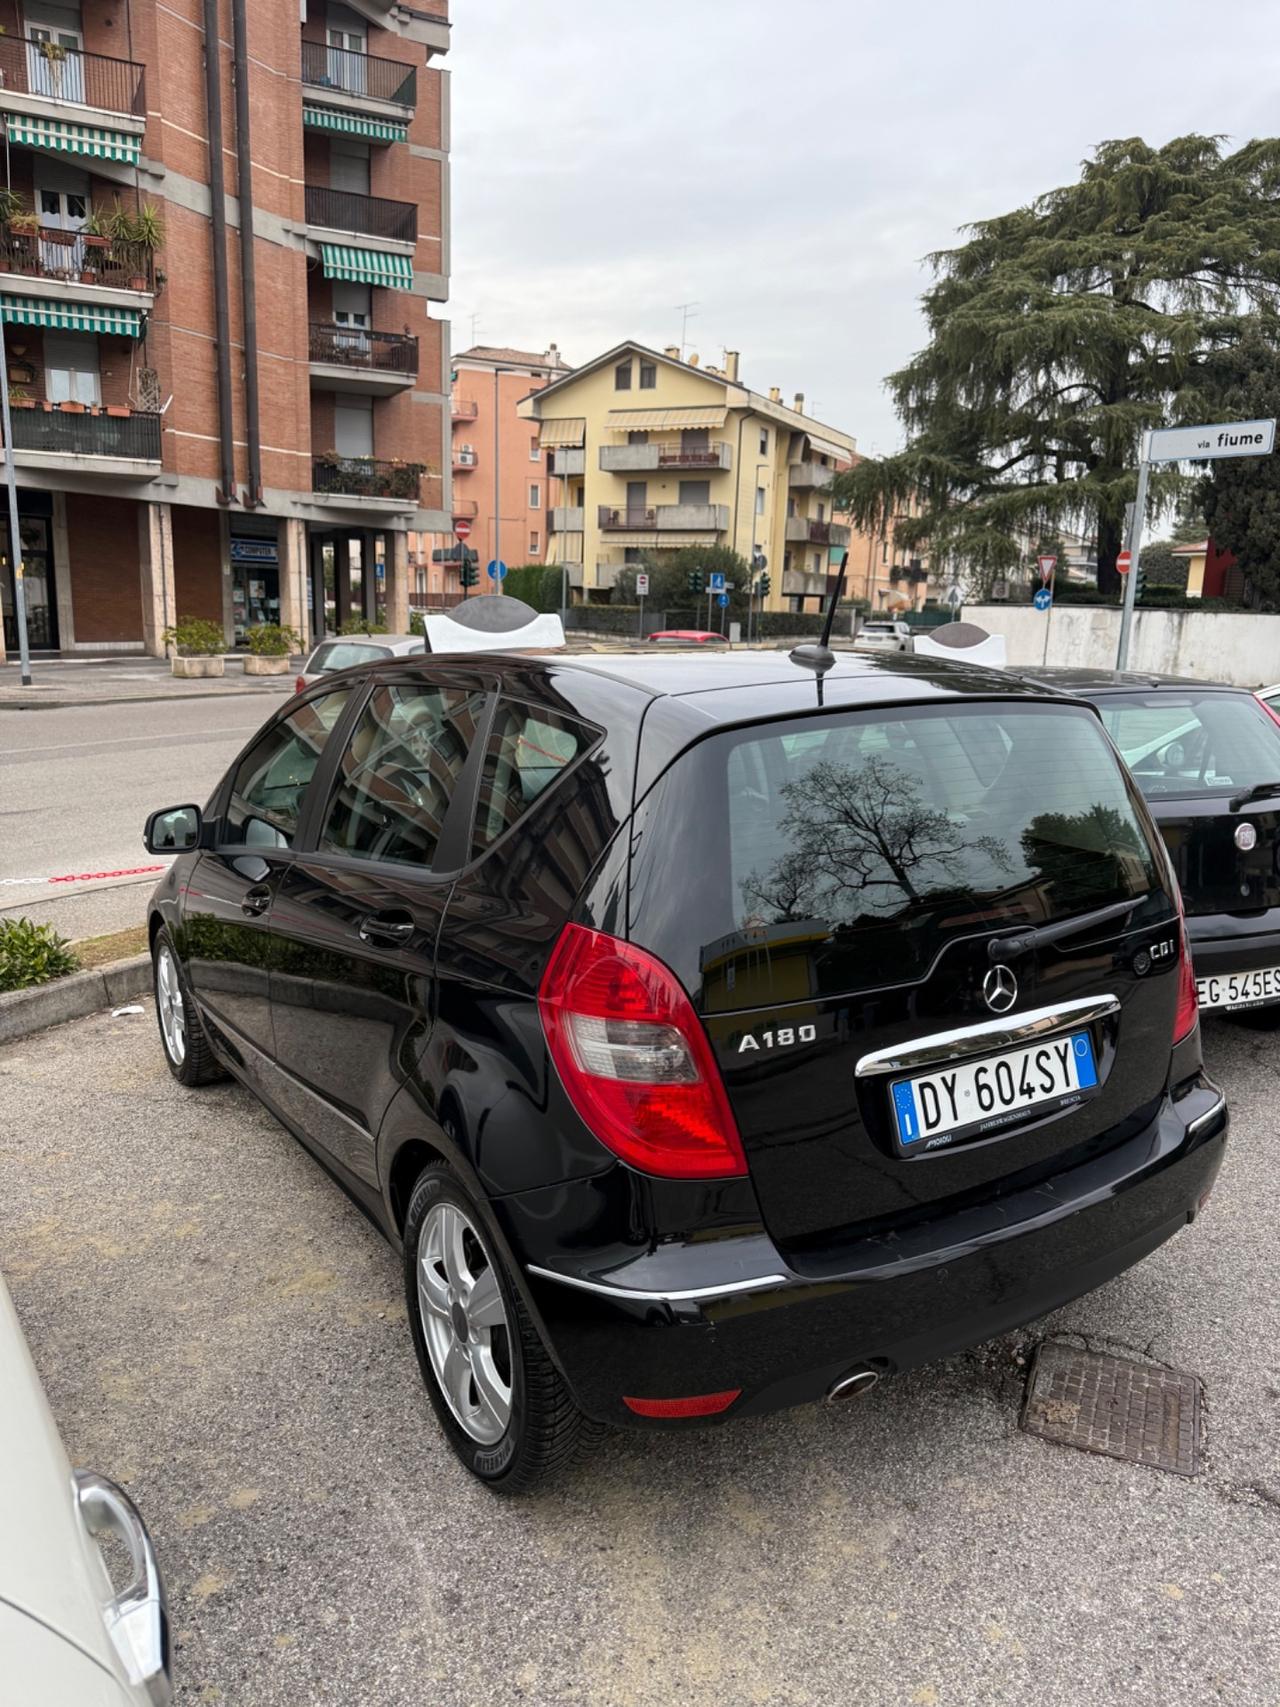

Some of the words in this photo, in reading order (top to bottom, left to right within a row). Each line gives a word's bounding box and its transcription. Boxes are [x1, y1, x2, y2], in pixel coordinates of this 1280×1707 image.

[1197, 440, 1211, 449] via
[1217, 433, 1264, 447] fiume
[1150, 939, 1174, 960] CDI
[1228, 969, 1280, 1001] 545ES
[918, 1073, 958, 1130] DY
[974, 1042, 1071, 1112] 604SY
